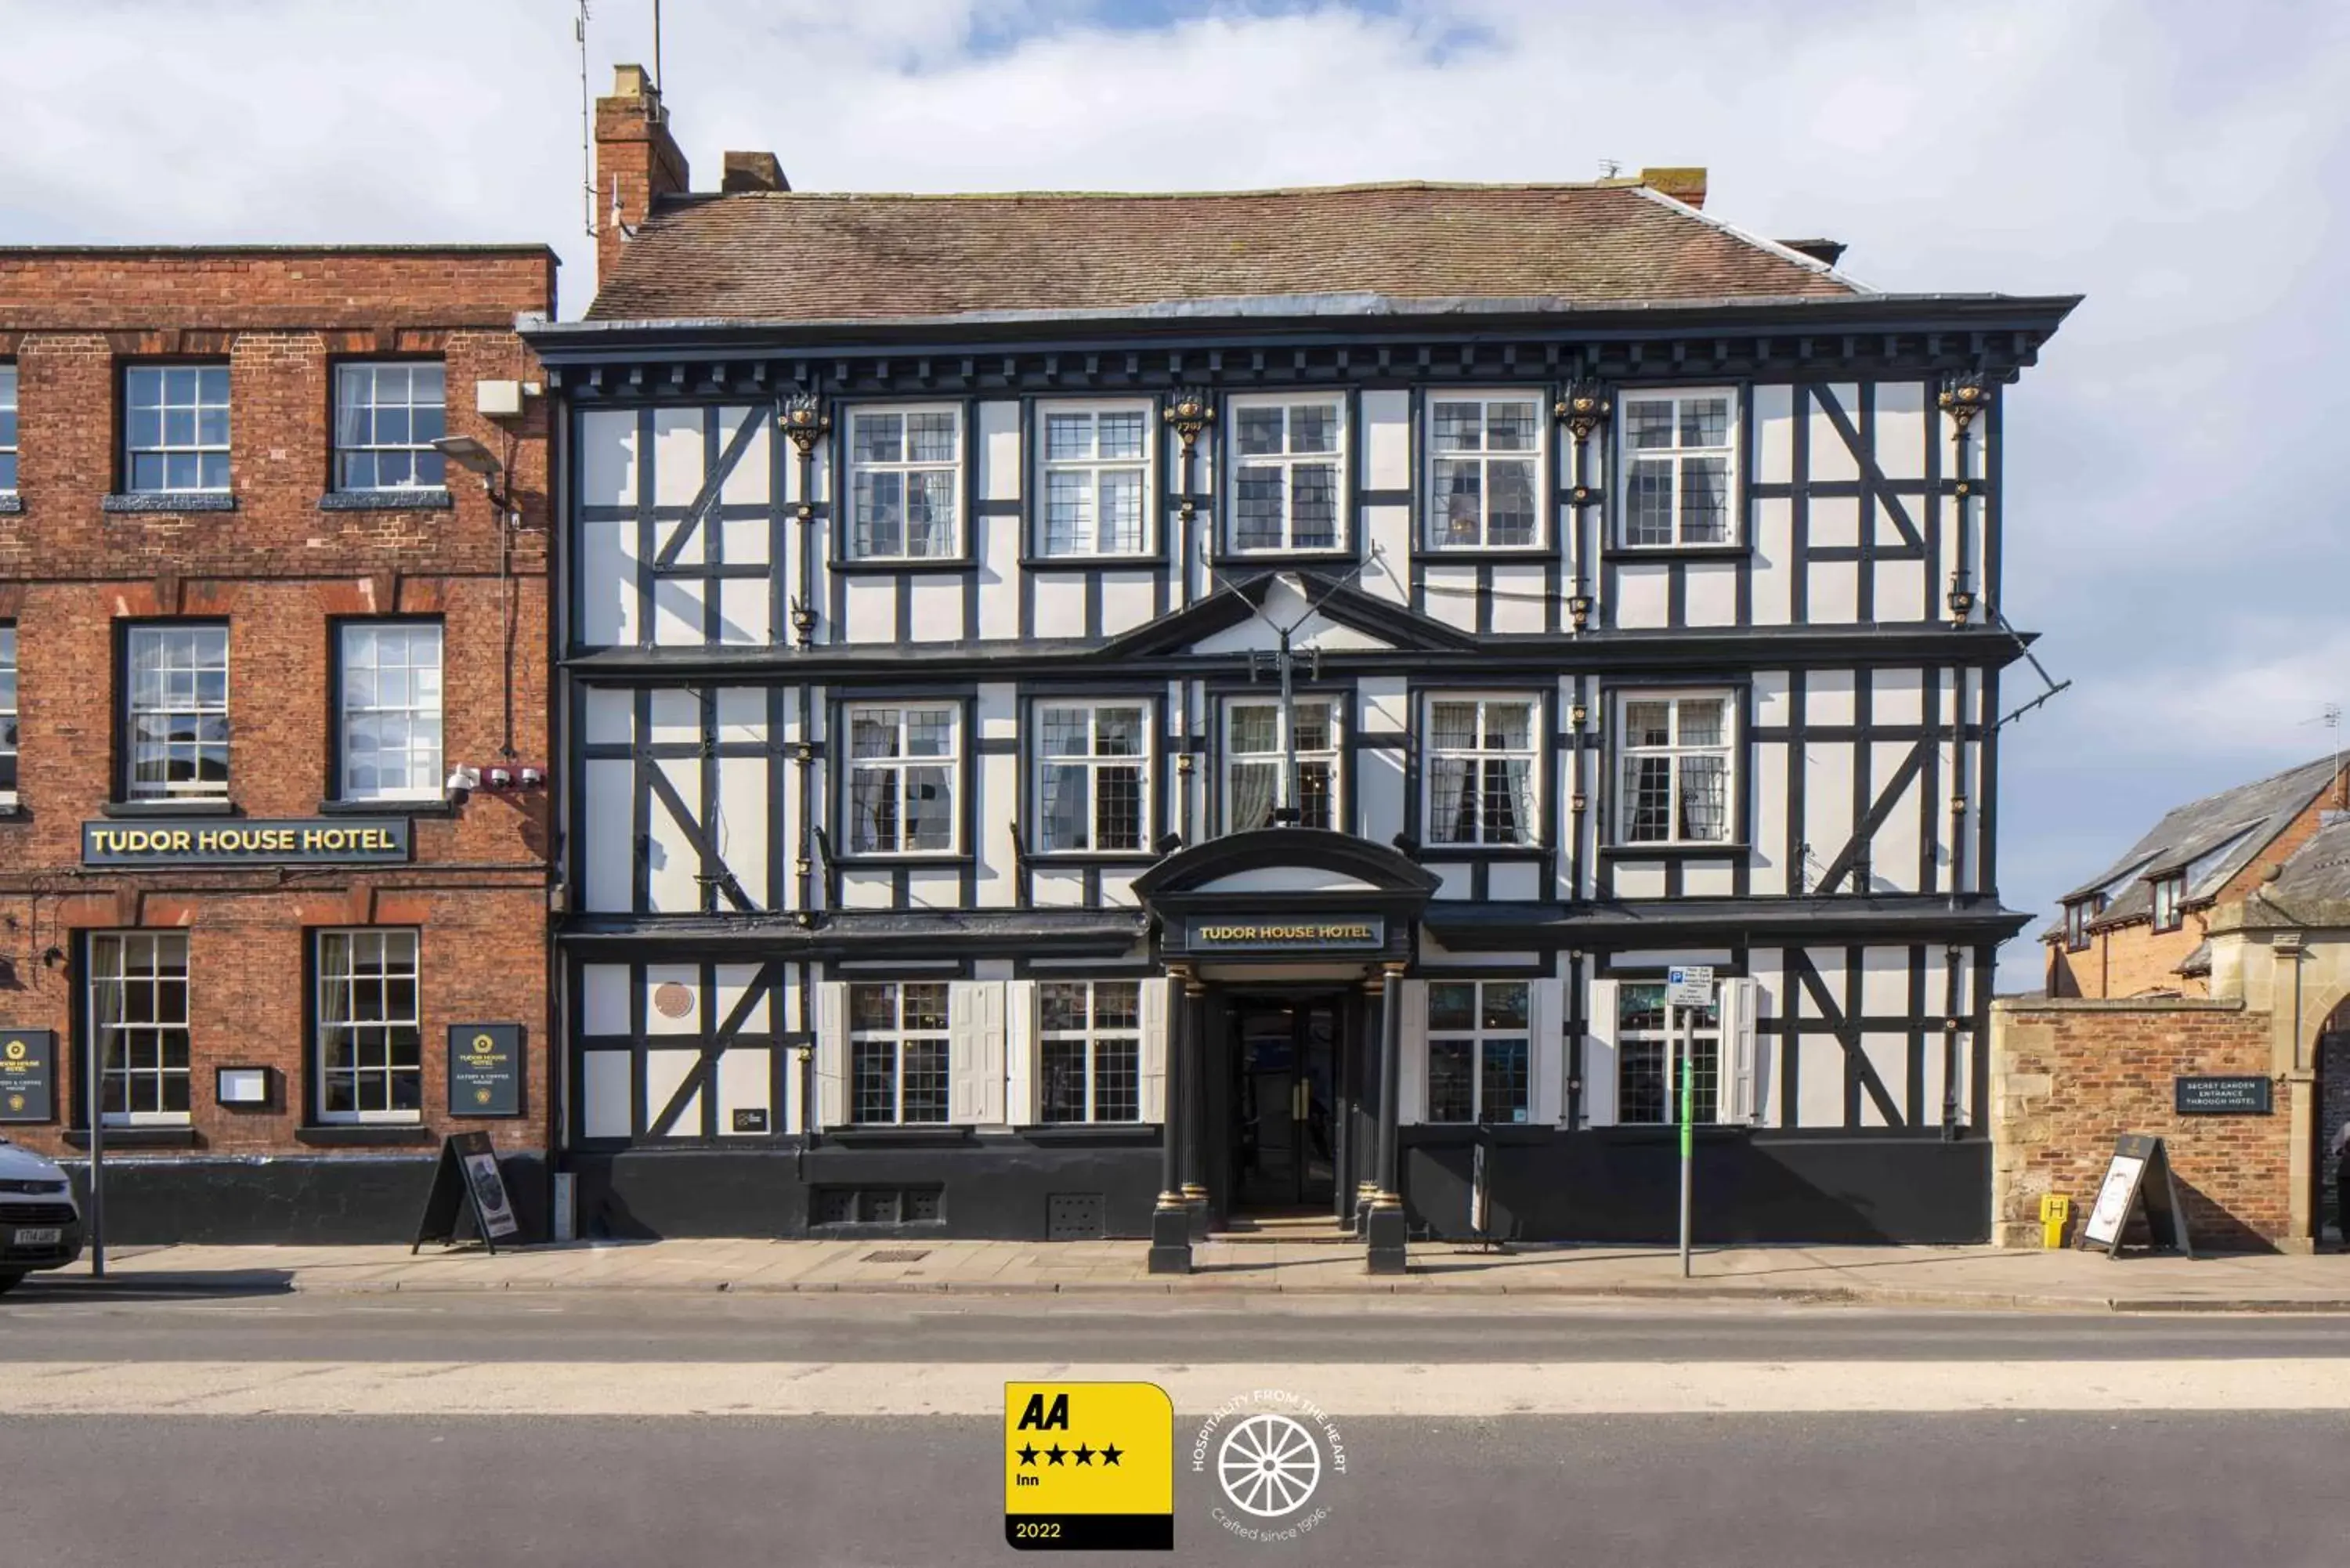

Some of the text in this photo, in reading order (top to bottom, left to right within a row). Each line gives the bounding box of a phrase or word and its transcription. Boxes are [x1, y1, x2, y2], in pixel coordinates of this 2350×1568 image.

[90, 828, 396, 851] TUDOR HOUSE HOTEL
[1199, 925, 1371, 939] TUDOR HOUSE HOTEL
[2048, 1201, 2064, 1218] H
